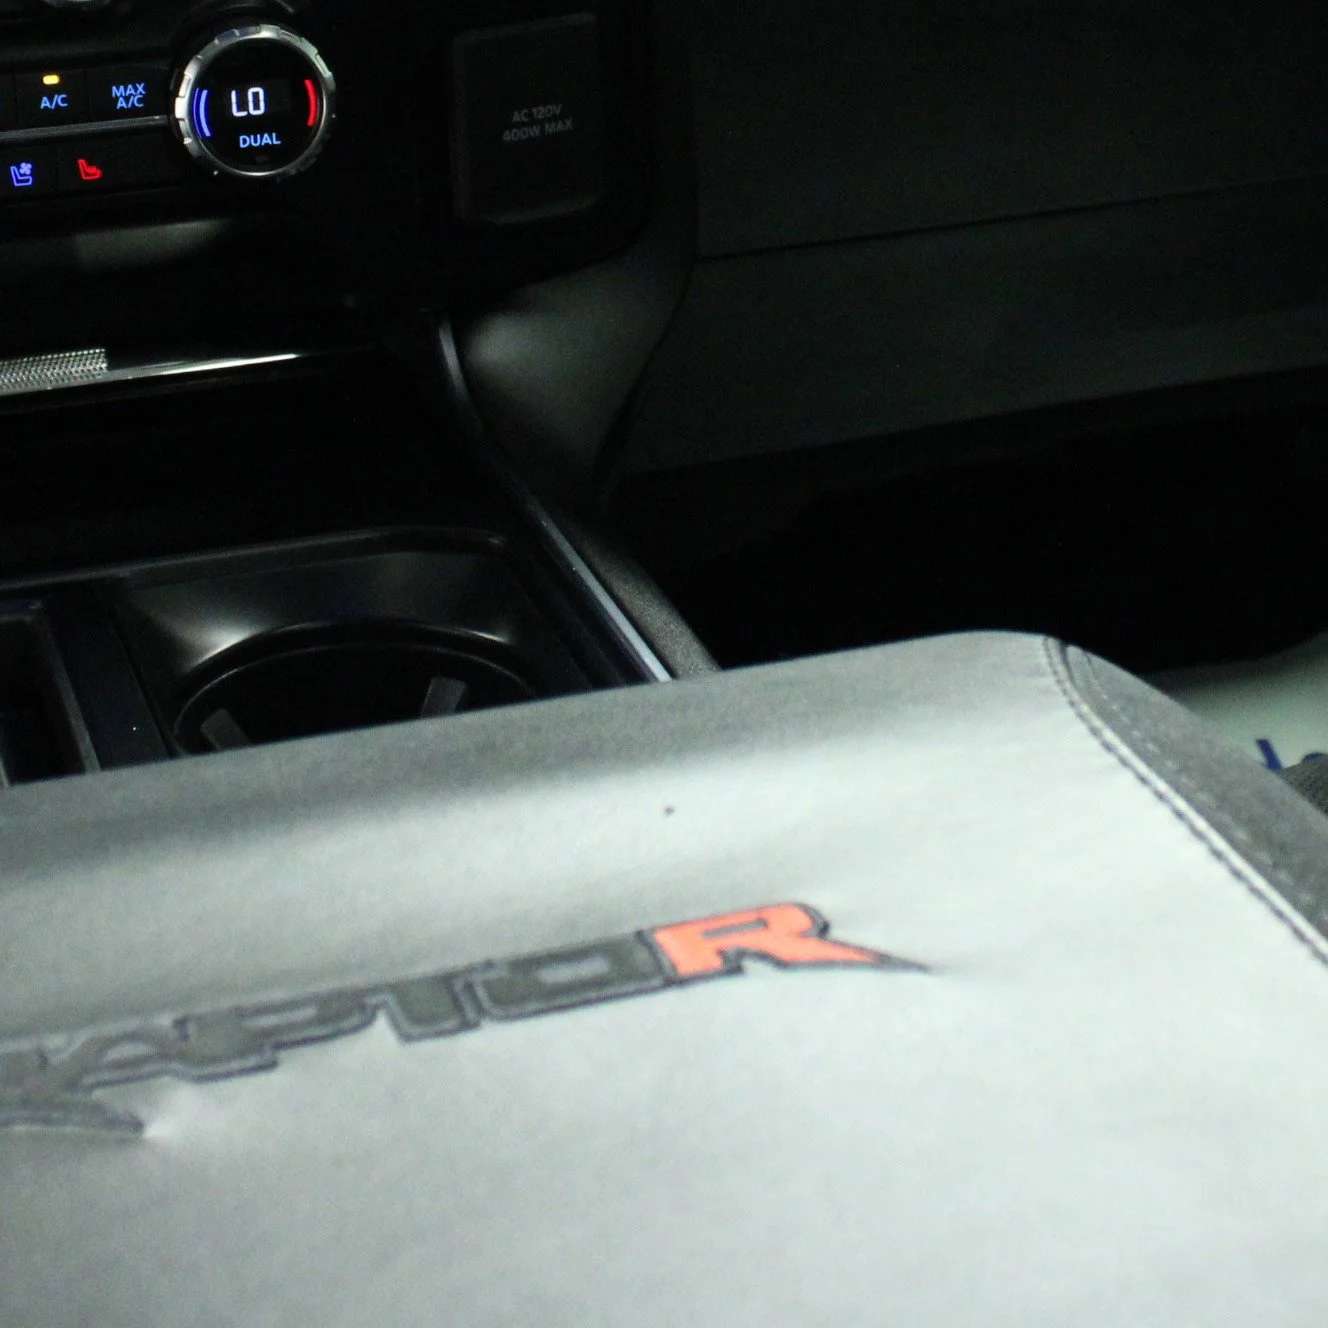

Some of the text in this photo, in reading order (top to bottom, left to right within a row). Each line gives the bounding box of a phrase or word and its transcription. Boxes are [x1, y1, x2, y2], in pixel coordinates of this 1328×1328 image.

[112, 83, 146, 97] MAX
[40, 94, 69, 110] A/C
[116, 95, 144, 110] A/C
[231, 86, 266, 117] LO
[512, 104, 562, 122] AC 120V
[545, 119, 573, 135] MAX
[239, 133, 281, 148] DUAL
